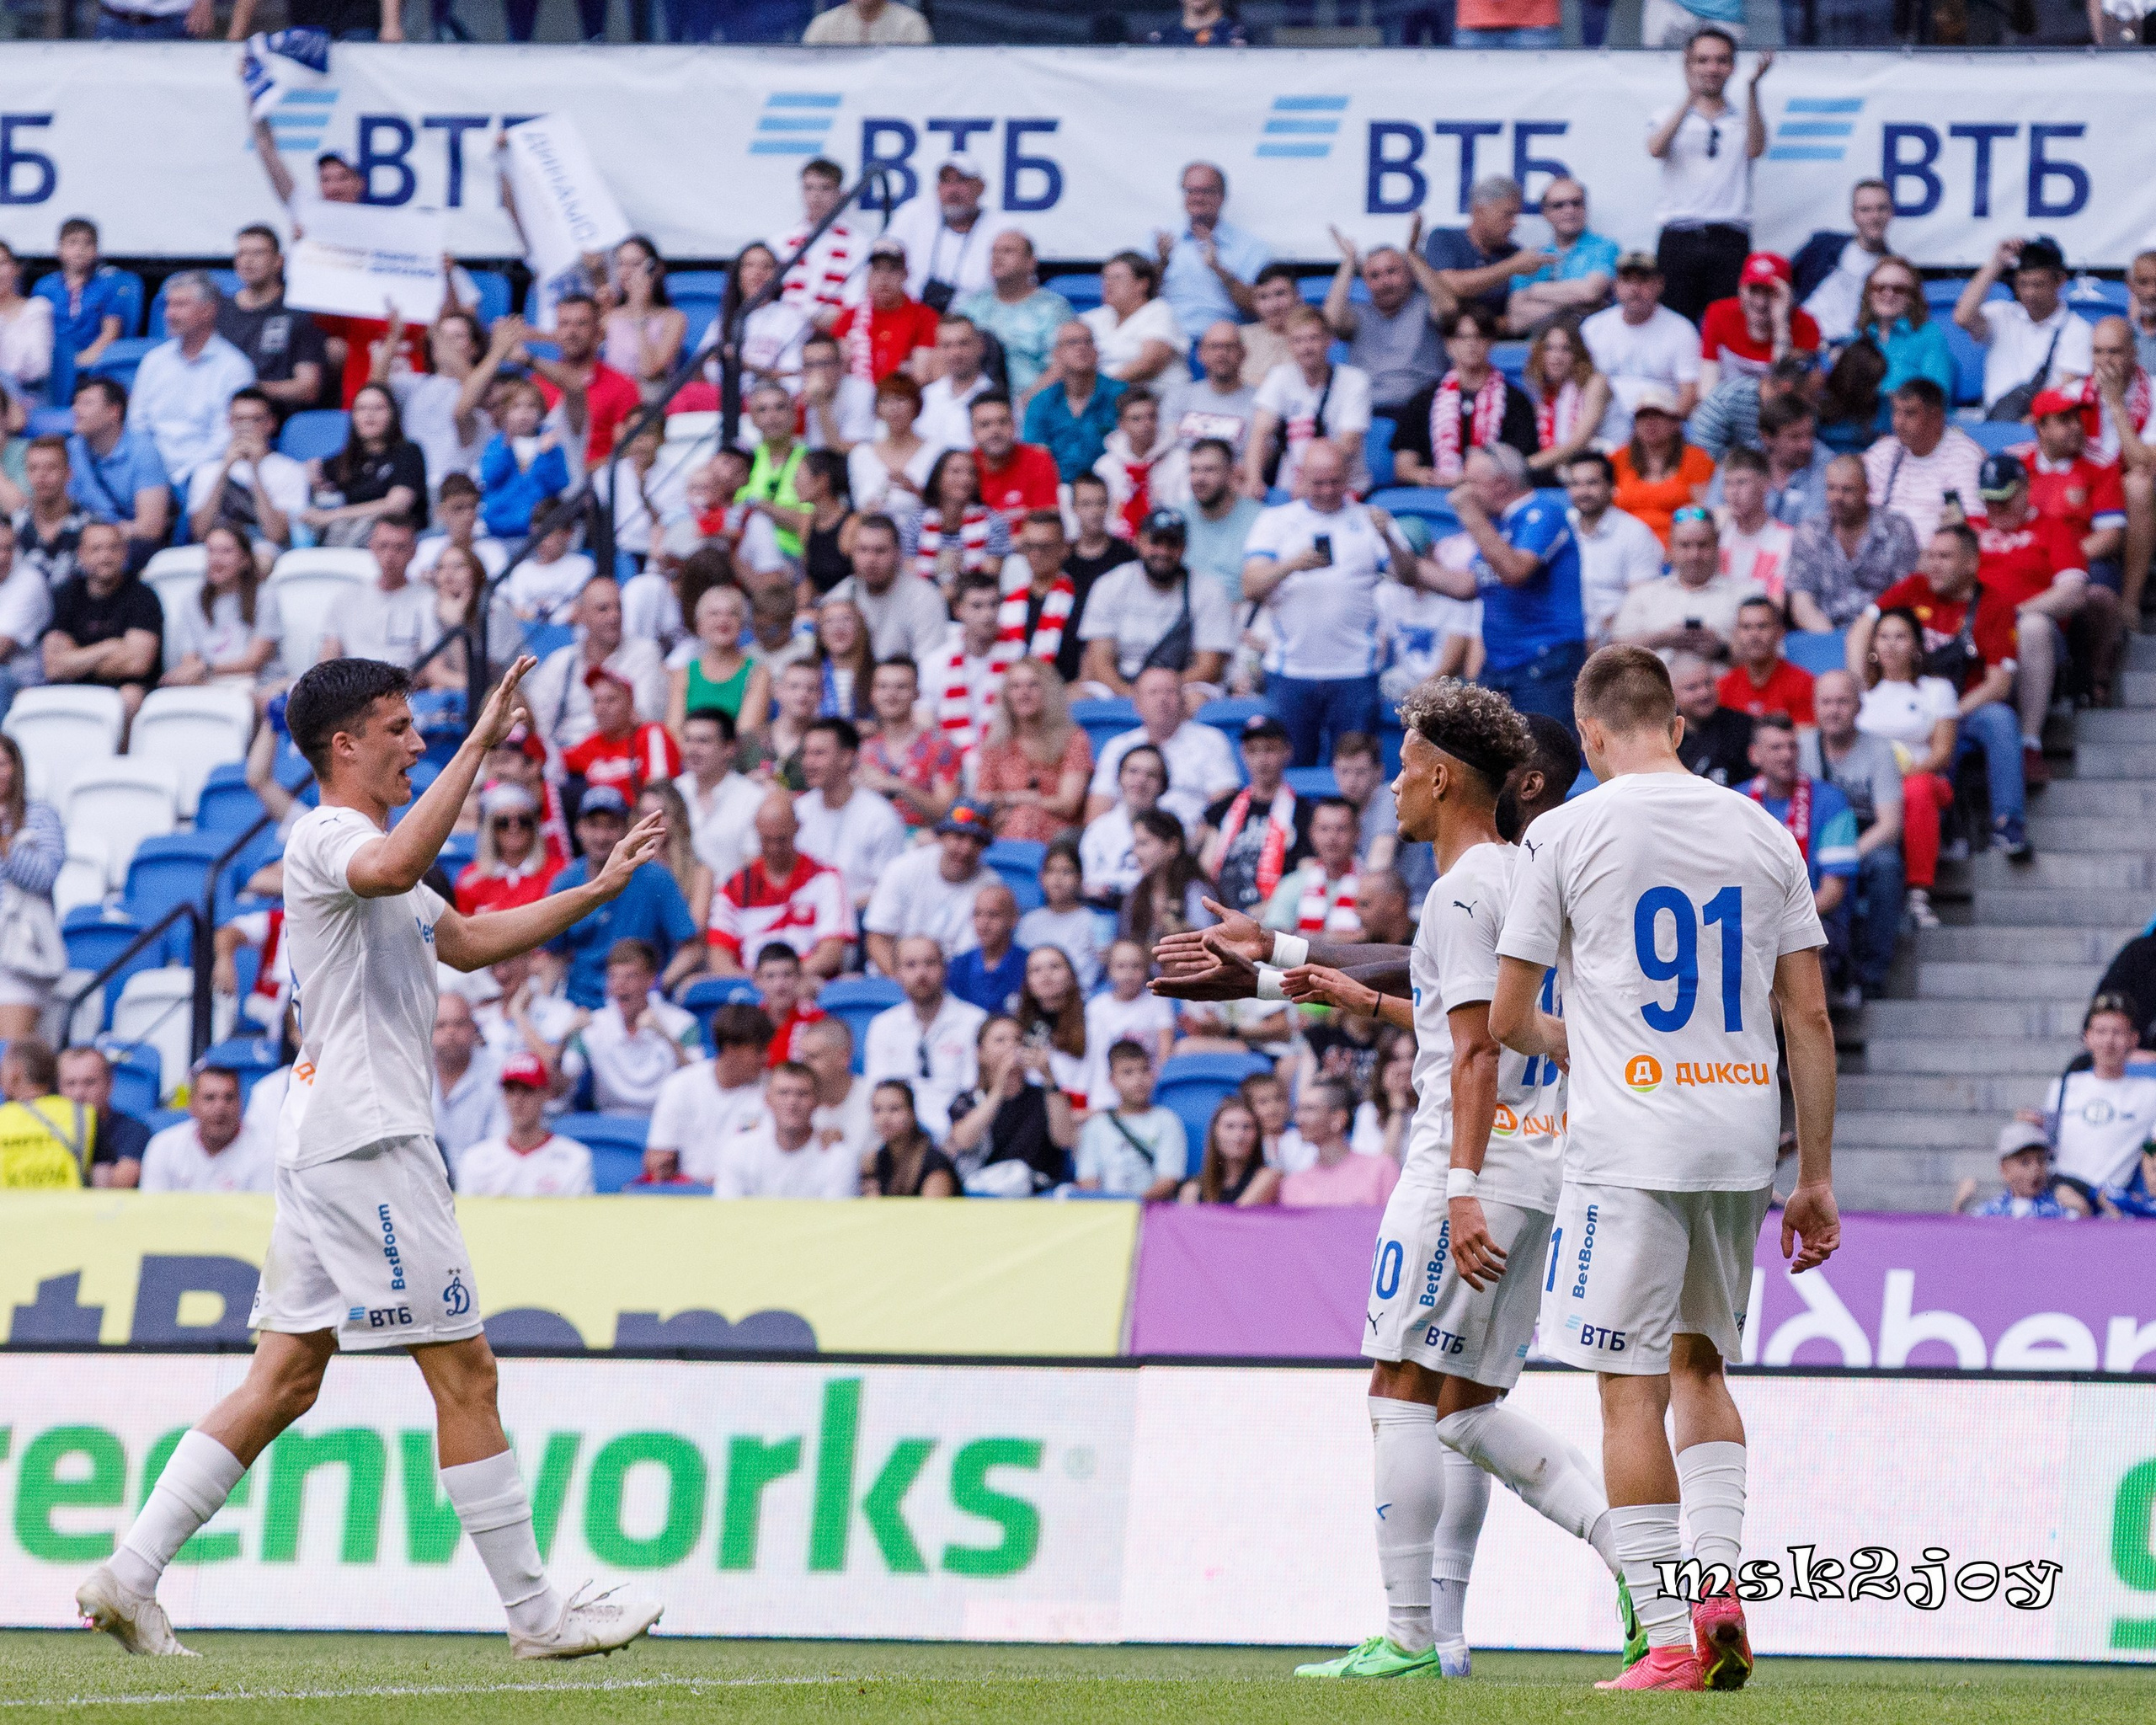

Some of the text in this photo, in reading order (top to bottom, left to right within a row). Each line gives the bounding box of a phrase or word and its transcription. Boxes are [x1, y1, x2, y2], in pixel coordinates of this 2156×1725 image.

[357, 113, 549, 208] ВТ
[861, 118, 1065, 212] ВТБ
[1366, 120, 1570, 215] ВТБ
[1881, 123, 2090, 218] ВТБ
[1634, 885, 1744, 1033] 91
[378, 1203, 405, 1290] BetBoom
[1419, 1219, 1449, 1307] BetBoom
[1572, 1203, 1598, 1299] BetBoom
[369, 1306, 413, 1328] ВТБ
[1425, 1325, 1466, 1355] ВТБ
[1580, 1323, 1626, 1352] ВТБ
[0, 1377, 1045, 1578] enworks
